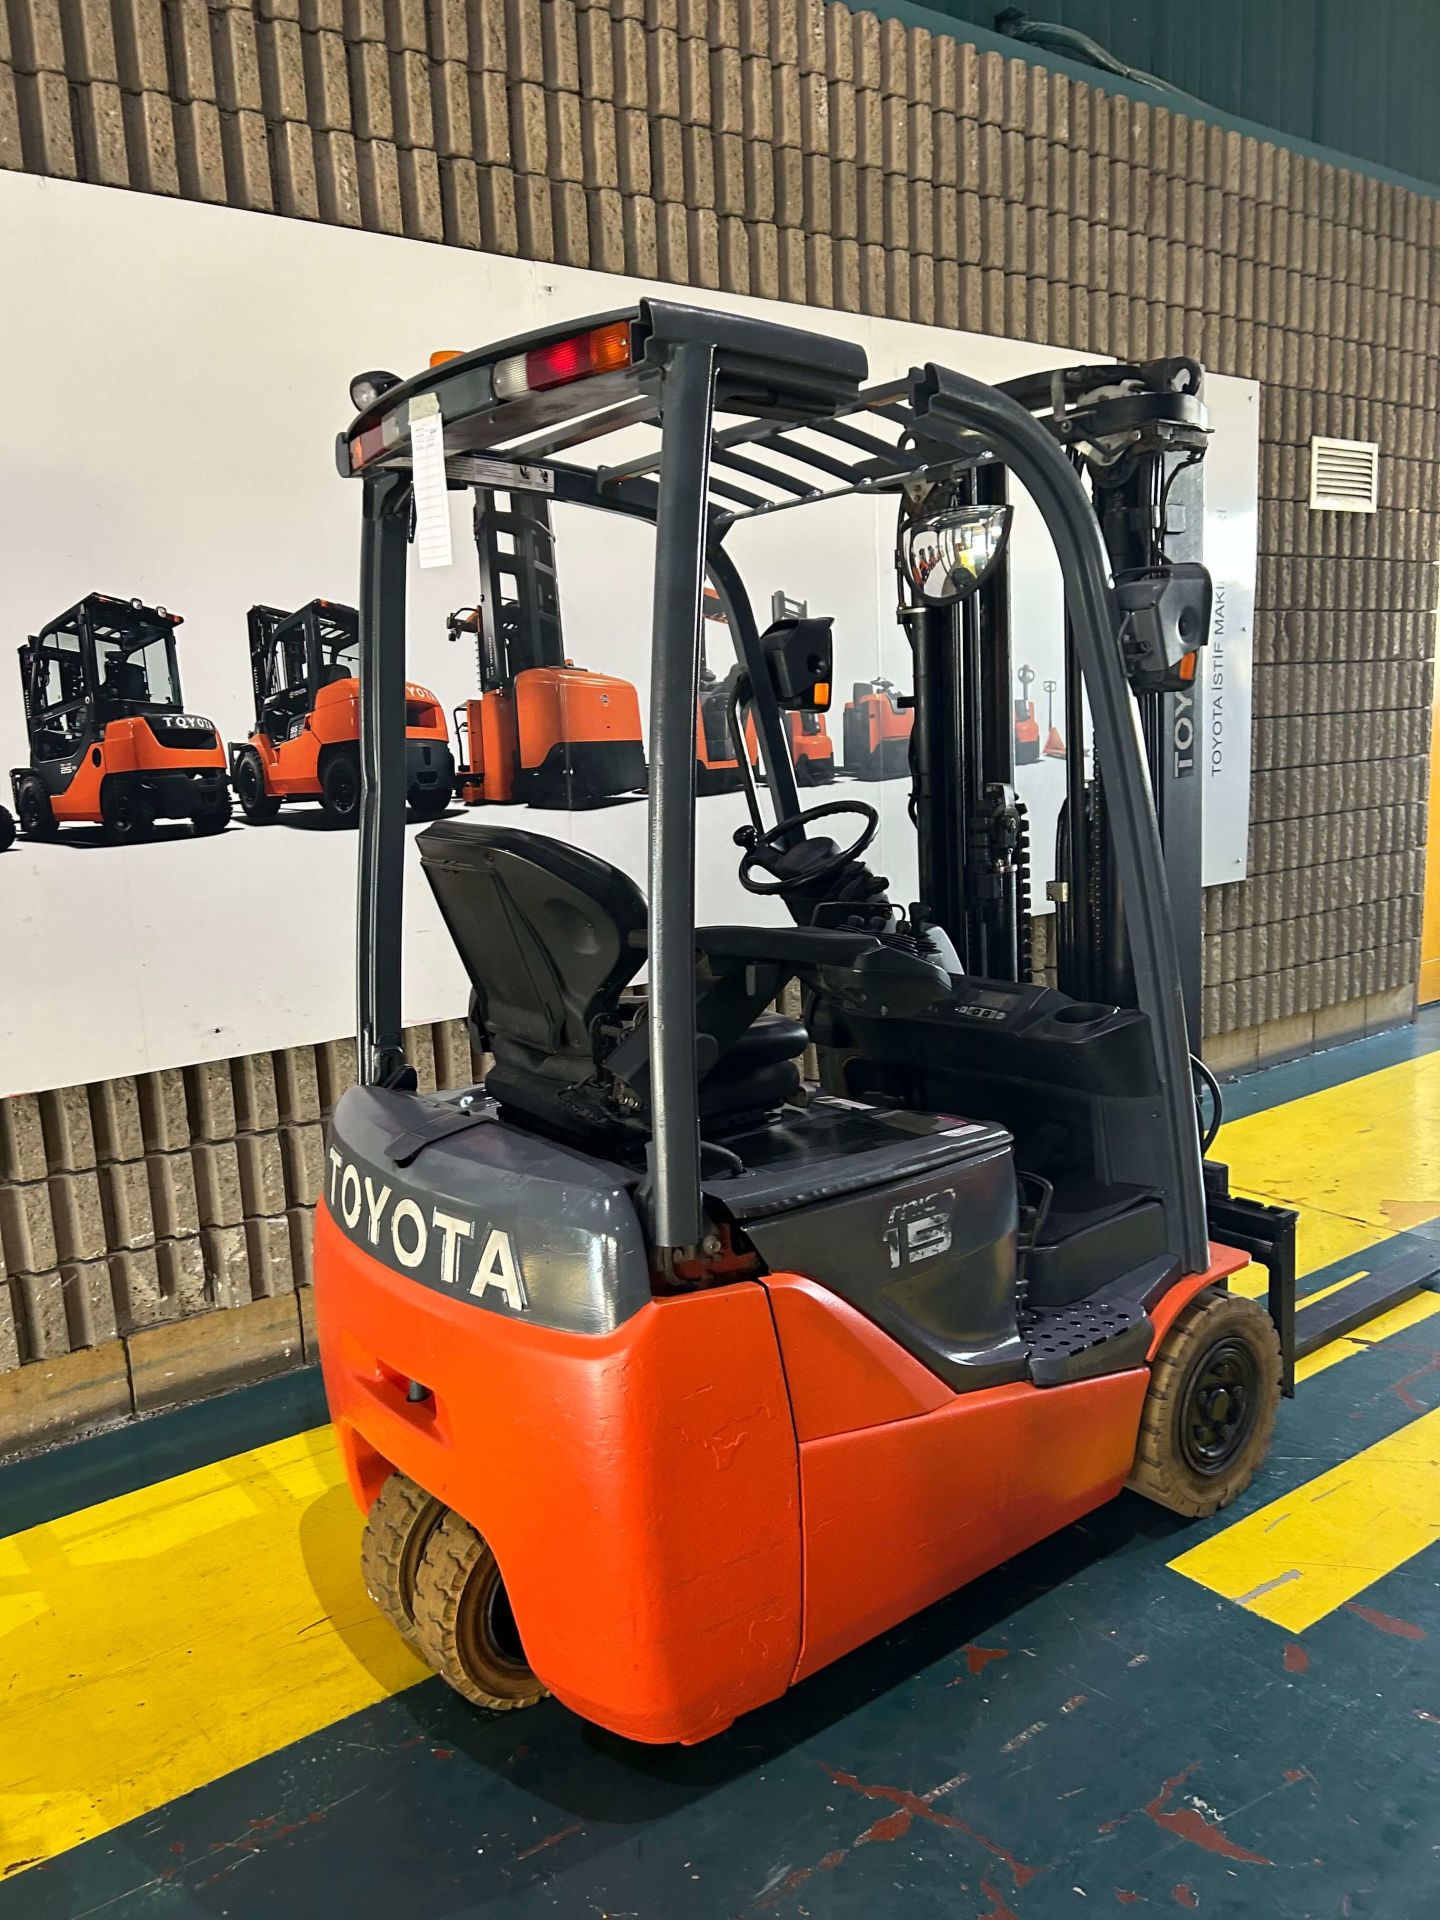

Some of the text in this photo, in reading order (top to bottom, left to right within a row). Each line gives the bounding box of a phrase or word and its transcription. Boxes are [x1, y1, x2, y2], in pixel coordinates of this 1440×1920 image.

[162, 716, 213, 729] TOYOTA
[1174, 692, 1194, 777] TOY
[1211, 697, 1224, 777] TOYOTA
[328, 1144, 527, 1311] TOYOTA
